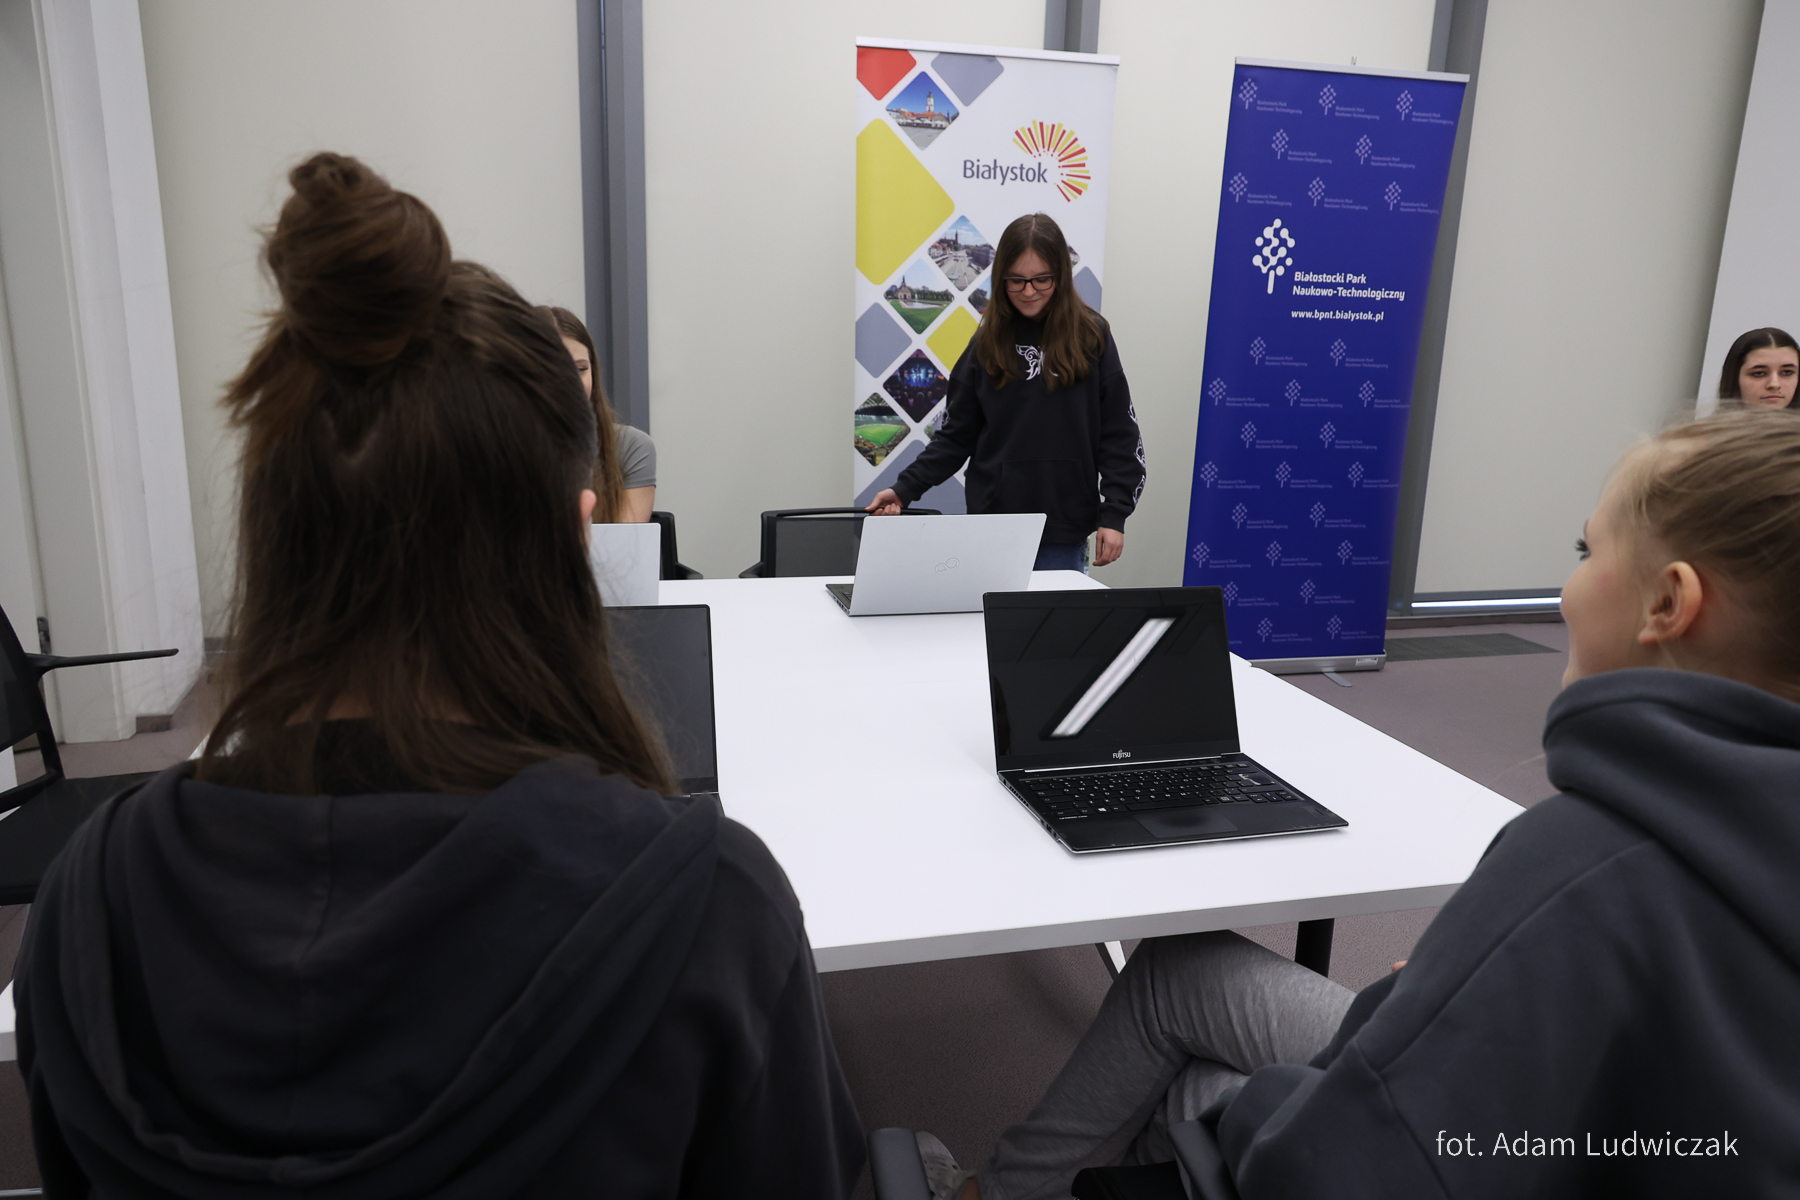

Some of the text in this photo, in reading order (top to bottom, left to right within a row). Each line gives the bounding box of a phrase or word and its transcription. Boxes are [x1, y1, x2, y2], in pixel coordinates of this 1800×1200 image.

[963, 159, 1048, 186] Białystok
[1294, 271, 1367, 284] Białostocki Park
[1292, 285, 1406, 302] Naukowo-Technologiczny
[1291, 309, 1385, 322] www.bpnt.bialystok.pl
[1112, 749, 1132, 760] FUJITSU
